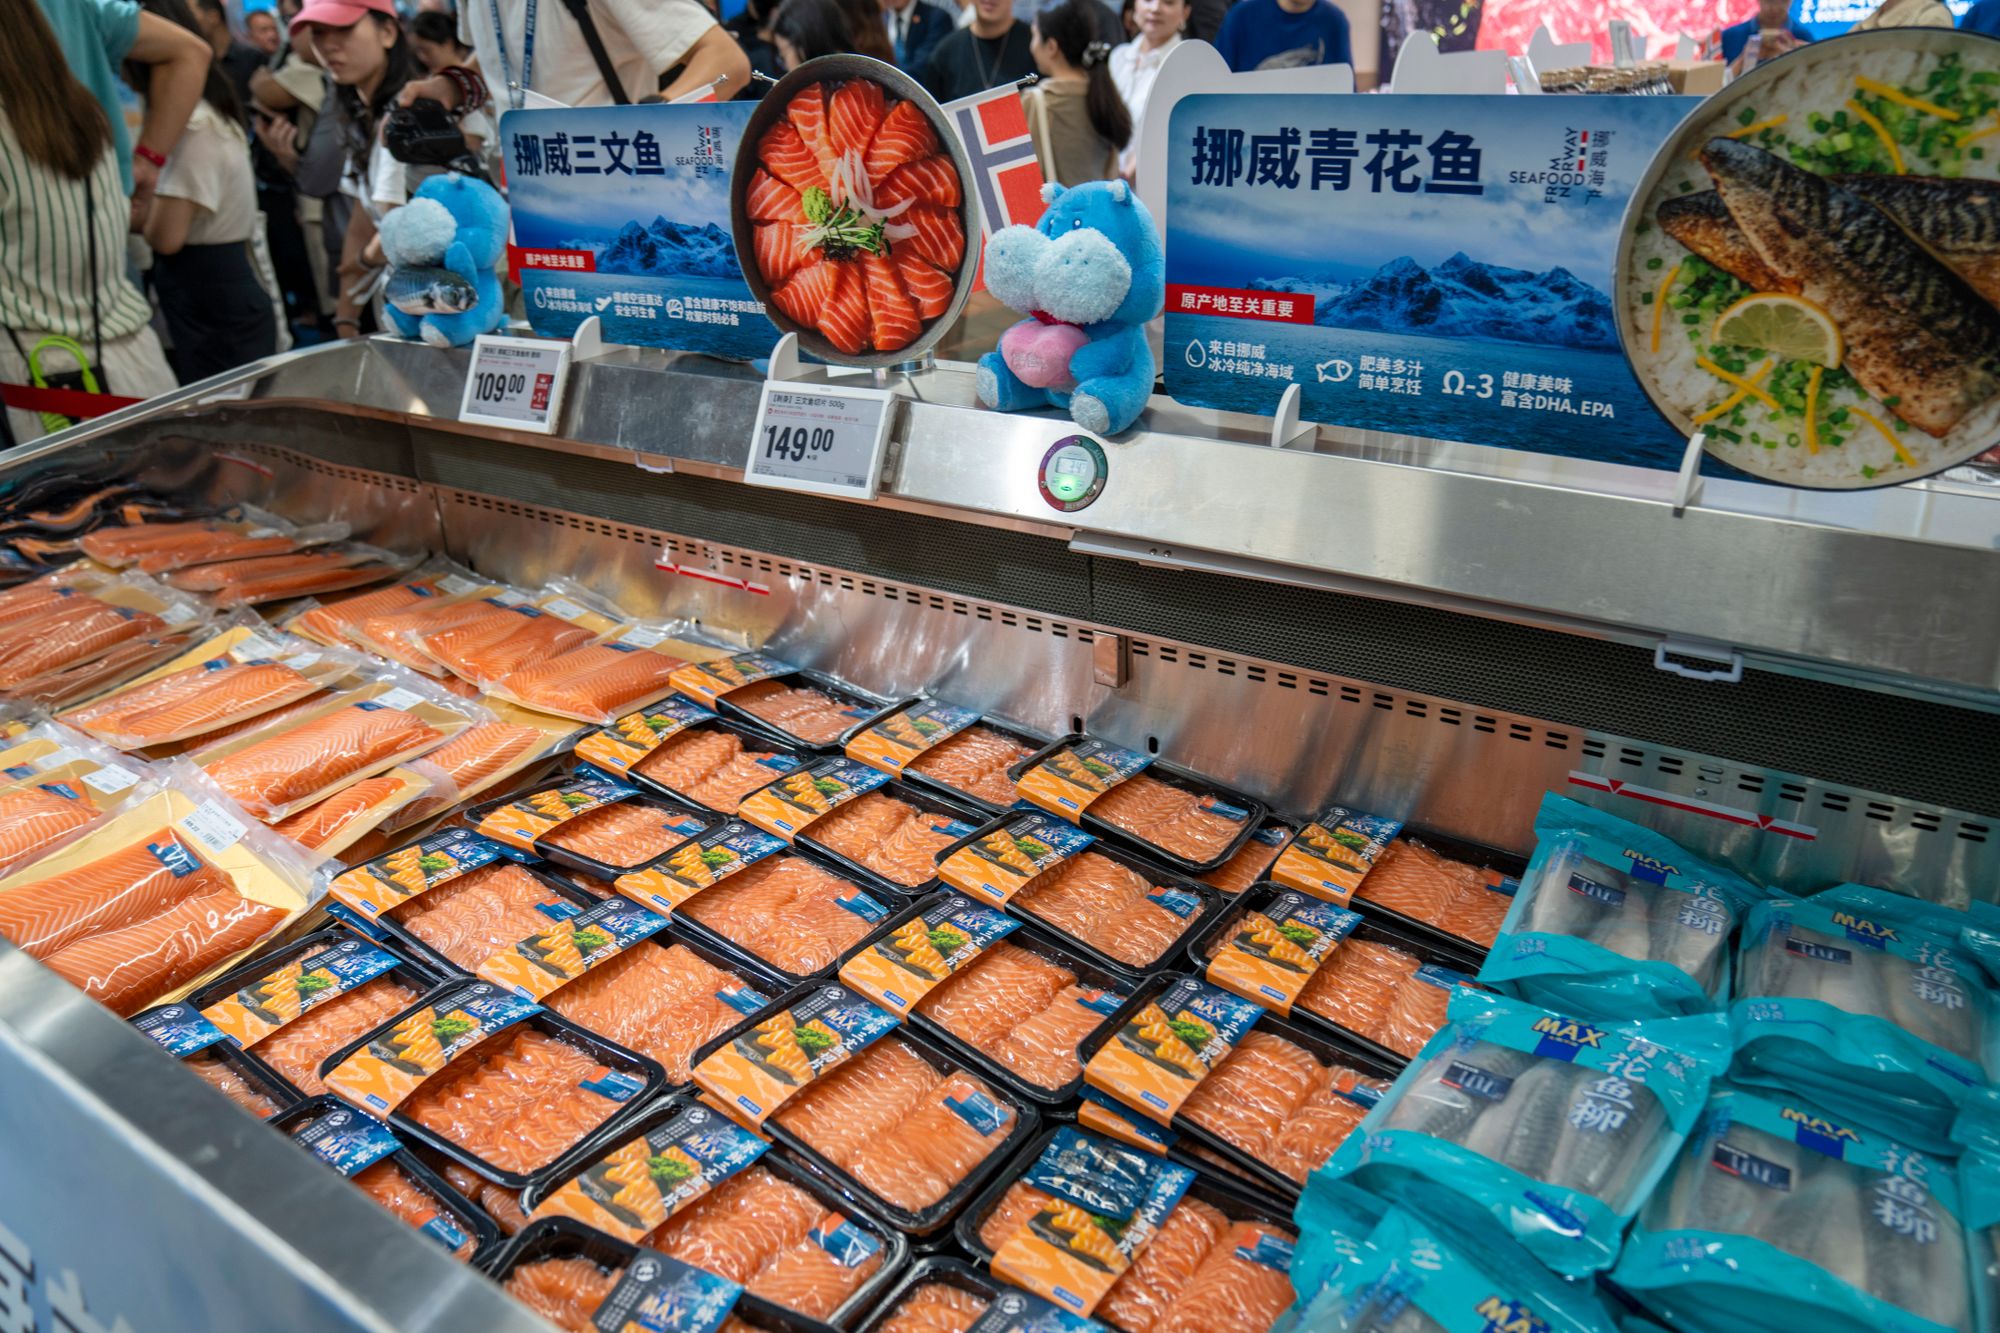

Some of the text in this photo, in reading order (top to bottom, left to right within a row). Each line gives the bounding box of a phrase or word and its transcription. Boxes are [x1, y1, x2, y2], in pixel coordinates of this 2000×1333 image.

[513, 129, 666, 177] 挪威三文鱼
[675, 156, 713, 166] SEAFOOD
[1192, 126, 1484, 195] 挪威青花鱼
[1558, 127, 1579, 198] NORWAY
[1509, 171, 1585, 186] SEAFOOD
[525, 252, 586, 269] 原产地至关重要
[614, 304, 657, 319] 安全可生食
[1180, 291, 1294, 318] 原产地至关重要
[1208, 338, 1266, 361] 来自挪威
[1207, 356, 1294, 382] 冰冷纯净海域
[1359, 354, 1425, 379] 肥美多汁
[1357, 373, 1423, 397] 简单烹饪
[1502, 370, 1574, 395] 健康美味
[600, 915, 632, 933] MAX
[951, 912, 984, 931] MAX
[1832, 911, 1901, 943] MAX
[465, 998, 500, 1018] MAX
[822, 1007, 858, 1032] MAX
[1188, 996, 1227, 1021] MAX
[1531, 1016, 1609, 1049] MAX
[315, 1135, 351, 1162] MAX
[683, 1133, 721, 1160] MAX
[637, 1293, 687, 1329] MAX
[1474, 1296, 1534, 1333] MA
